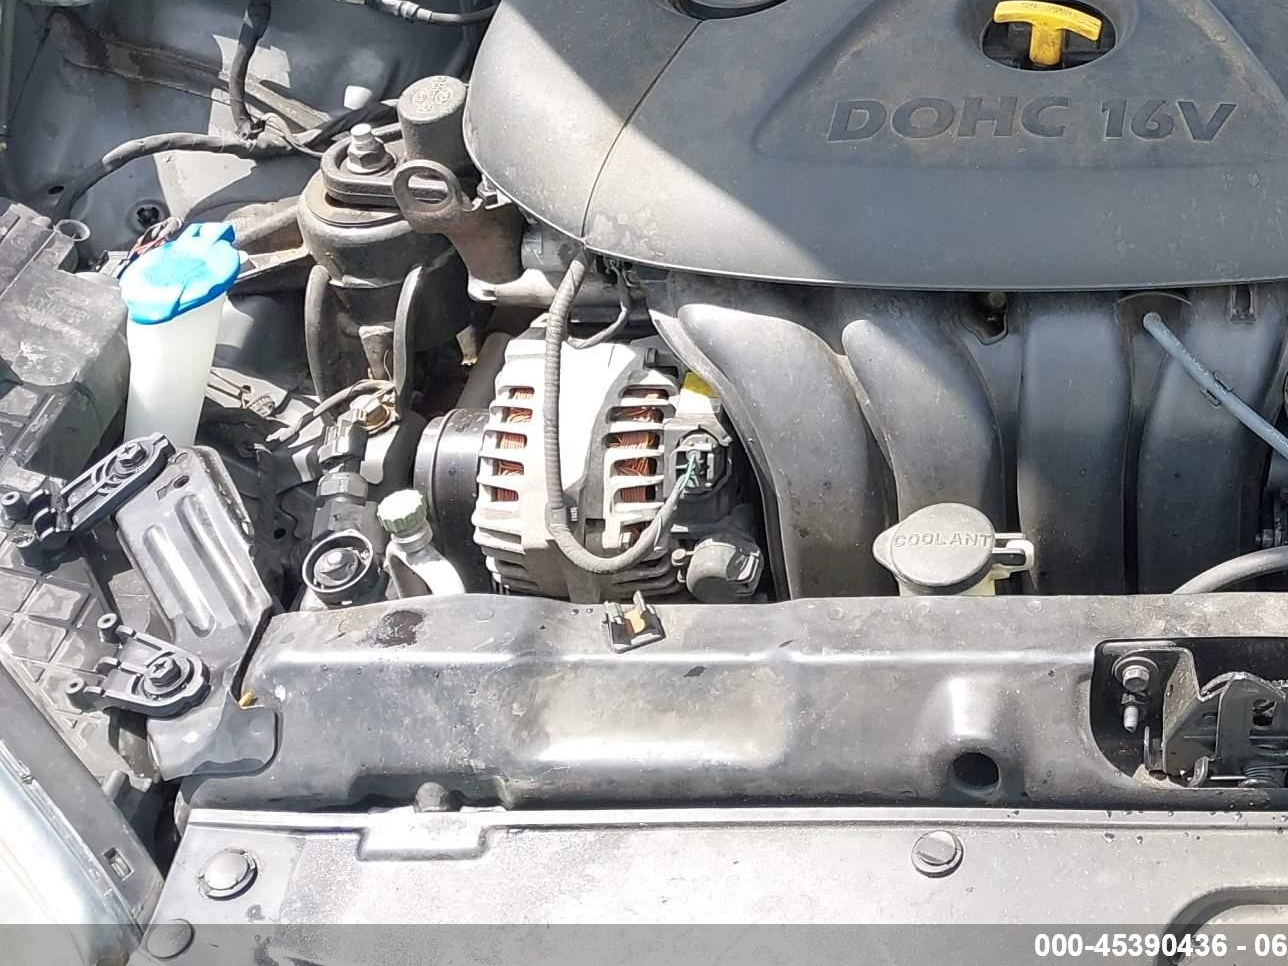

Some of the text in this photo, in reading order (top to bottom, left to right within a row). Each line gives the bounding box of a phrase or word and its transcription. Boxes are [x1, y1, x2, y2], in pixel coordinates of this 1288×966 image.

[828, 97, 1238, 143] DOHC 16V
[893, 532, 993, 548] COOLANT
